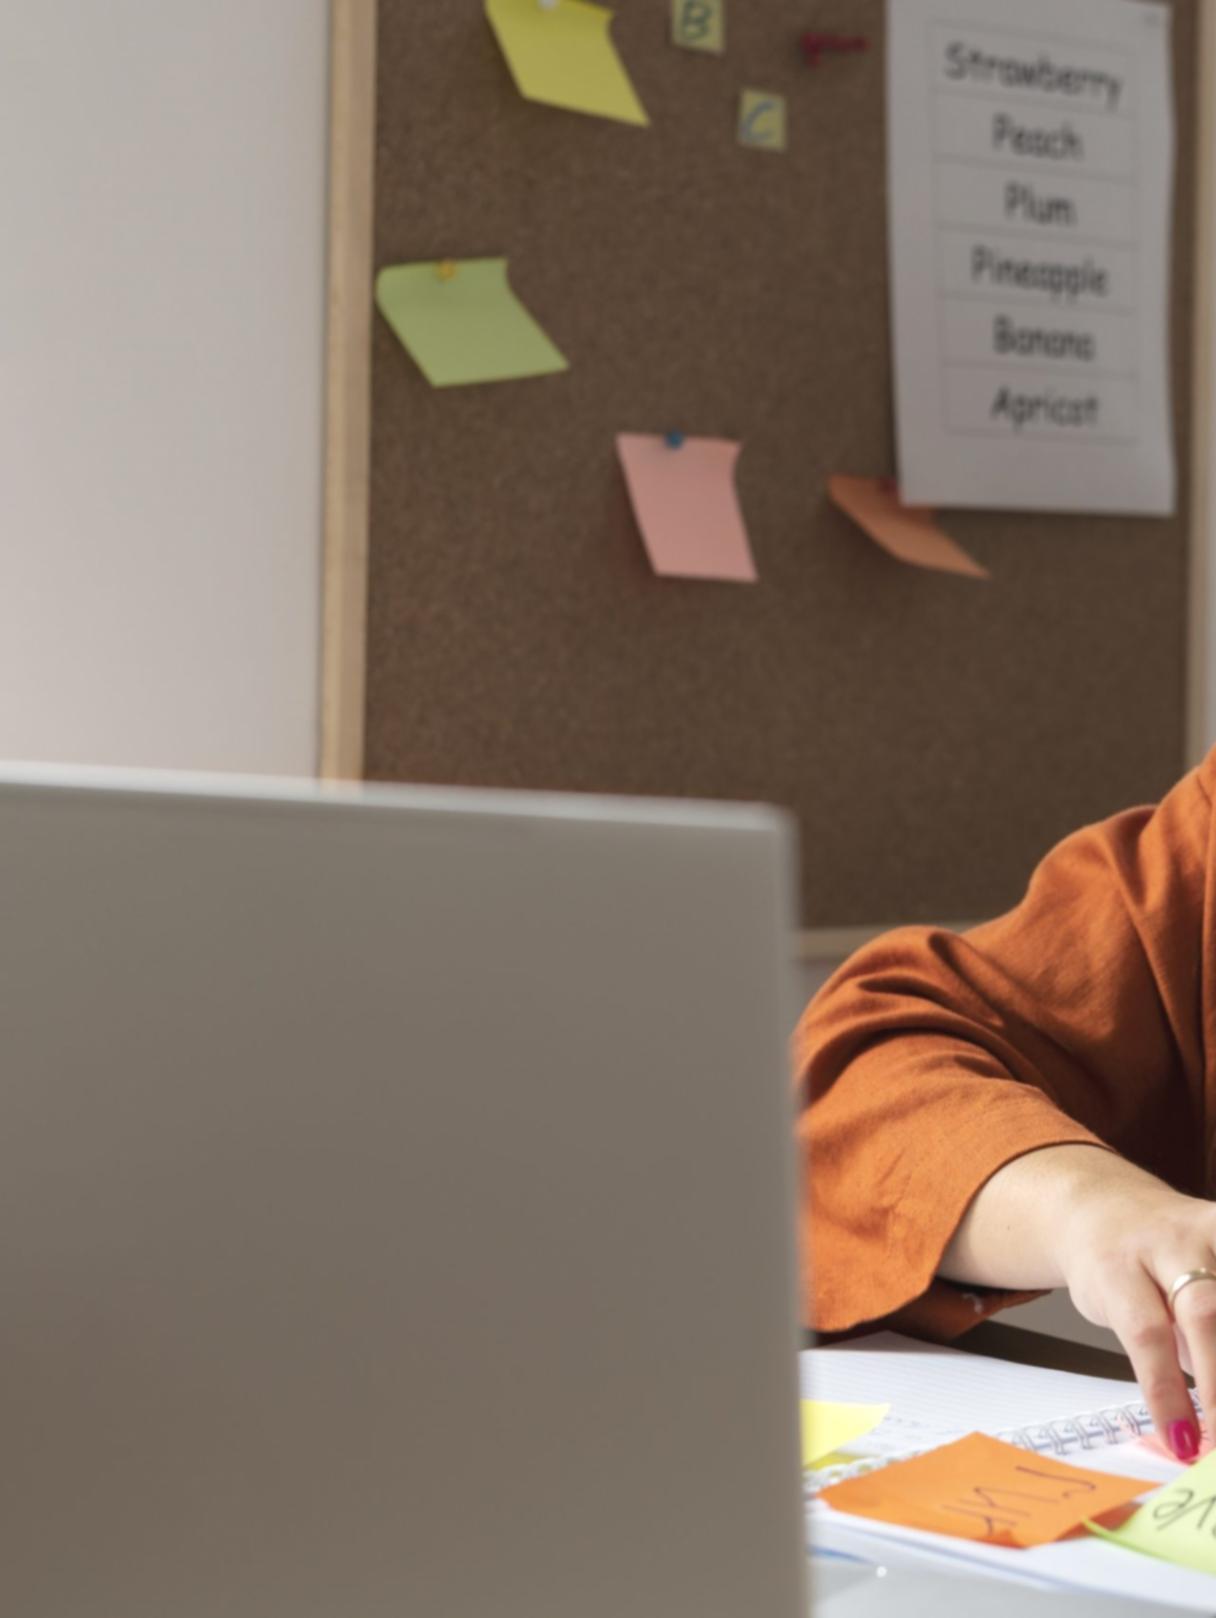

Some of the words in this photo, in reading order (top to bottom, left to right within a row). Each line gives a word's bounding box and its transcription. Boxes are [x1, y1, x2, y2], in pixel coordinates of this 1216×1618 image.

[945, 41, 1122, 110] Strawberry
[991, 112, 1083, 161] Peach
[1004, 182, 1076, 227] Plum
[970, 245, 1109, 302] Pineapple
[992, 315, 1096, 361] Banana
[990, 386, 1099, 431] Apricot
